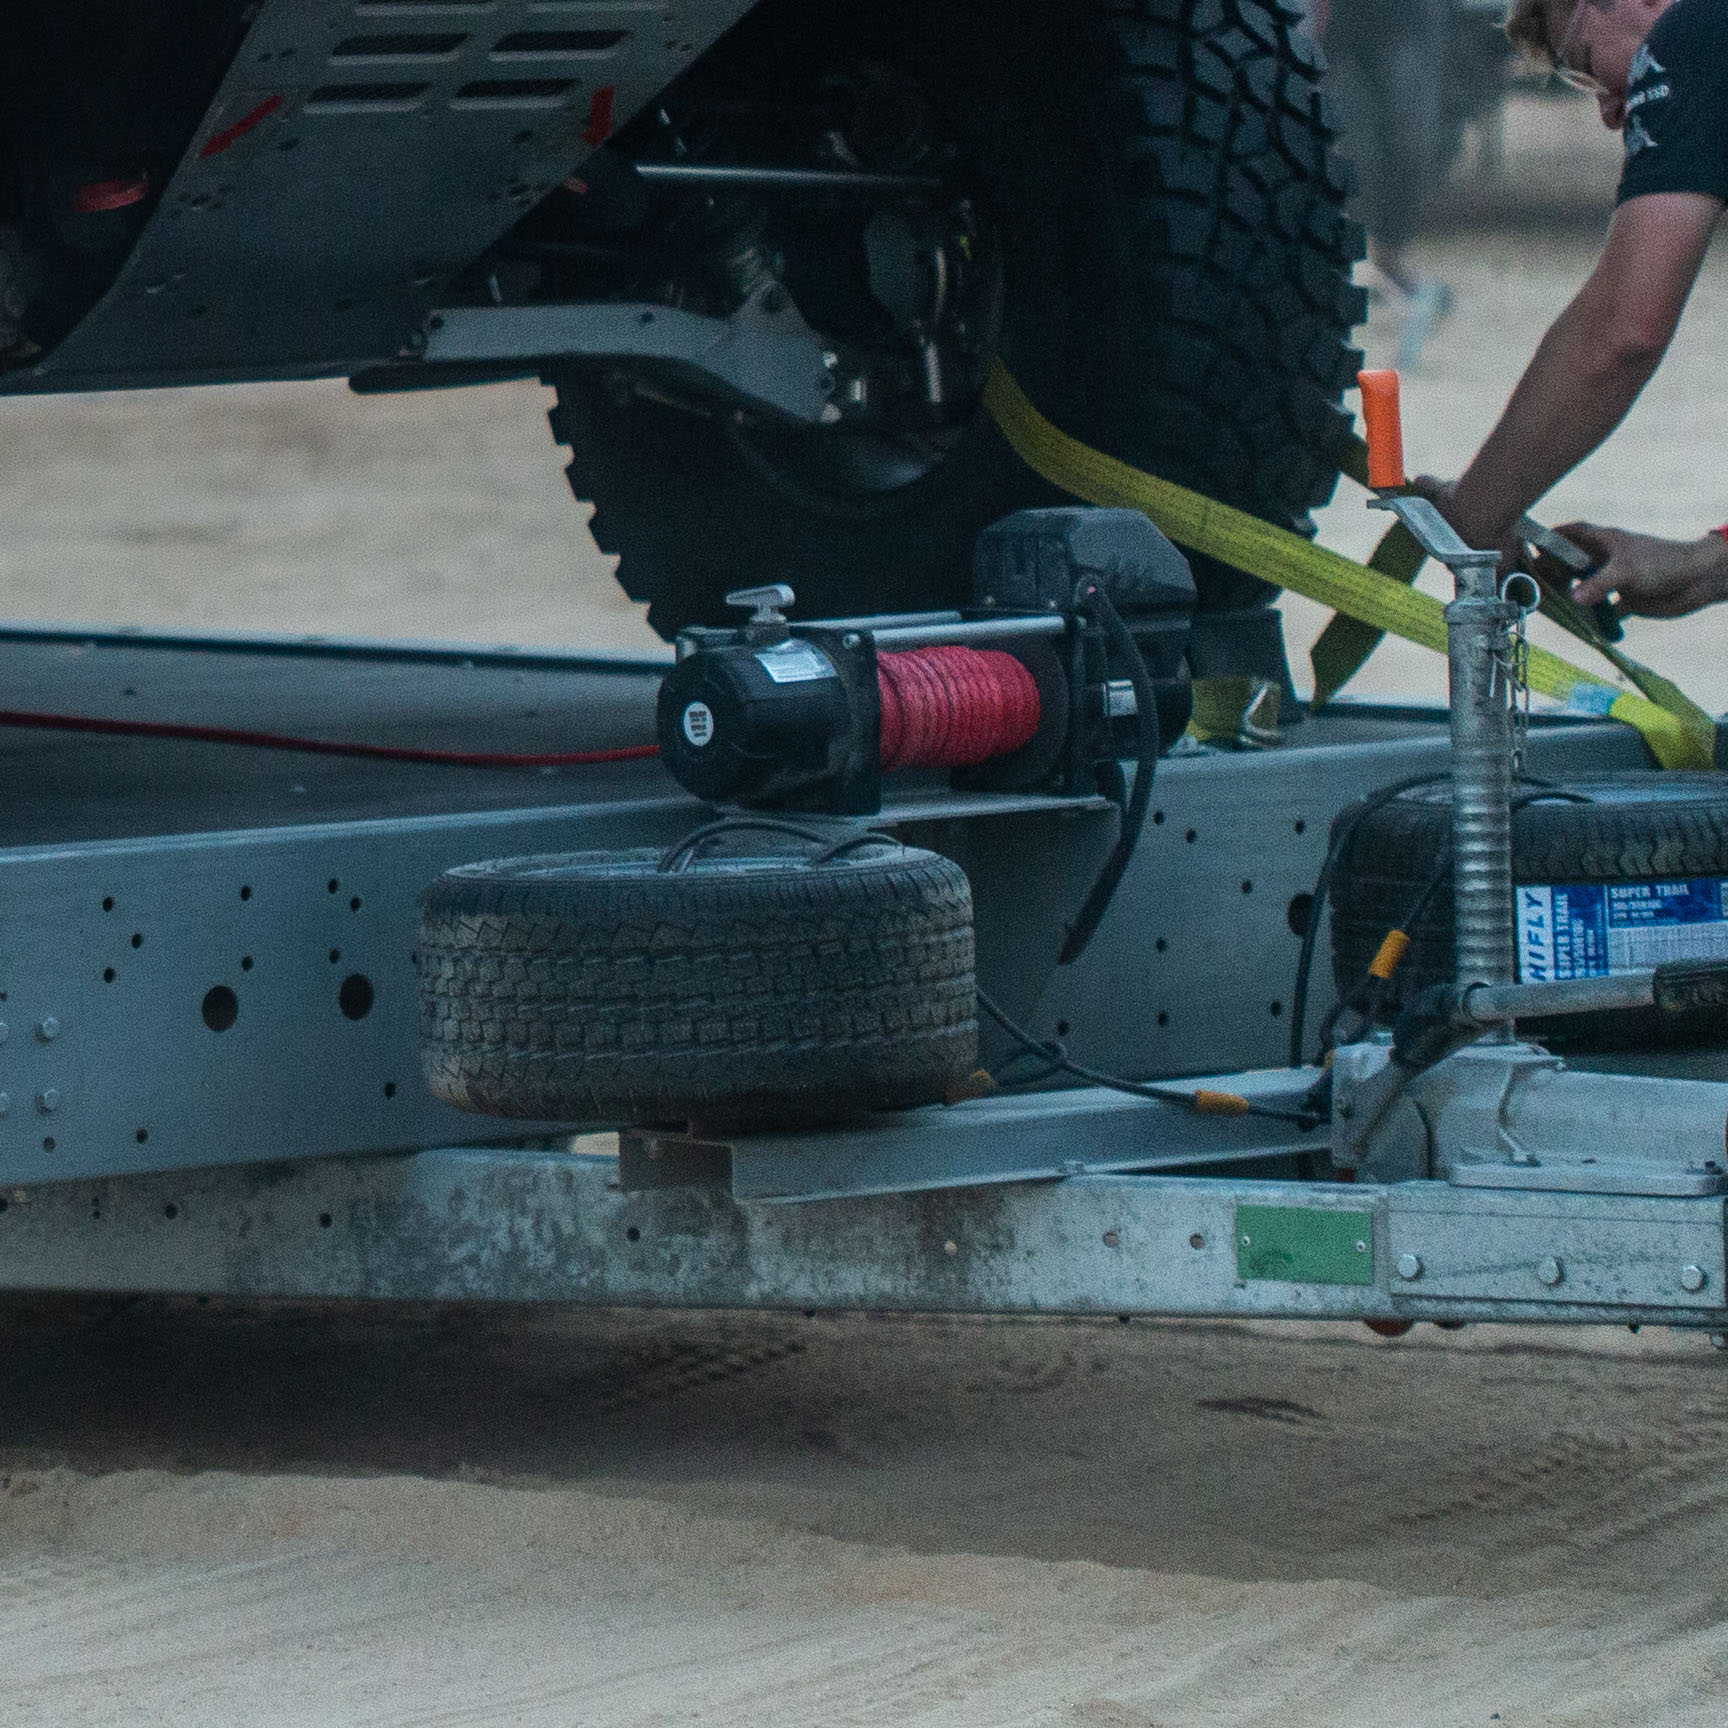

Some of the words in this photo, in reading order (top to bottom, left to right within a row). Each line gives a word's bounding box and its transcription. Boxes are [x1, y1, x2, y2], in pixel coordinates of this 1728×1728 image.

[1610, 886, 1652, 900] SUPER
[1655, 883, 1690, 897] TRAIL
[1525, 890, 1548, 983] HIFLY
